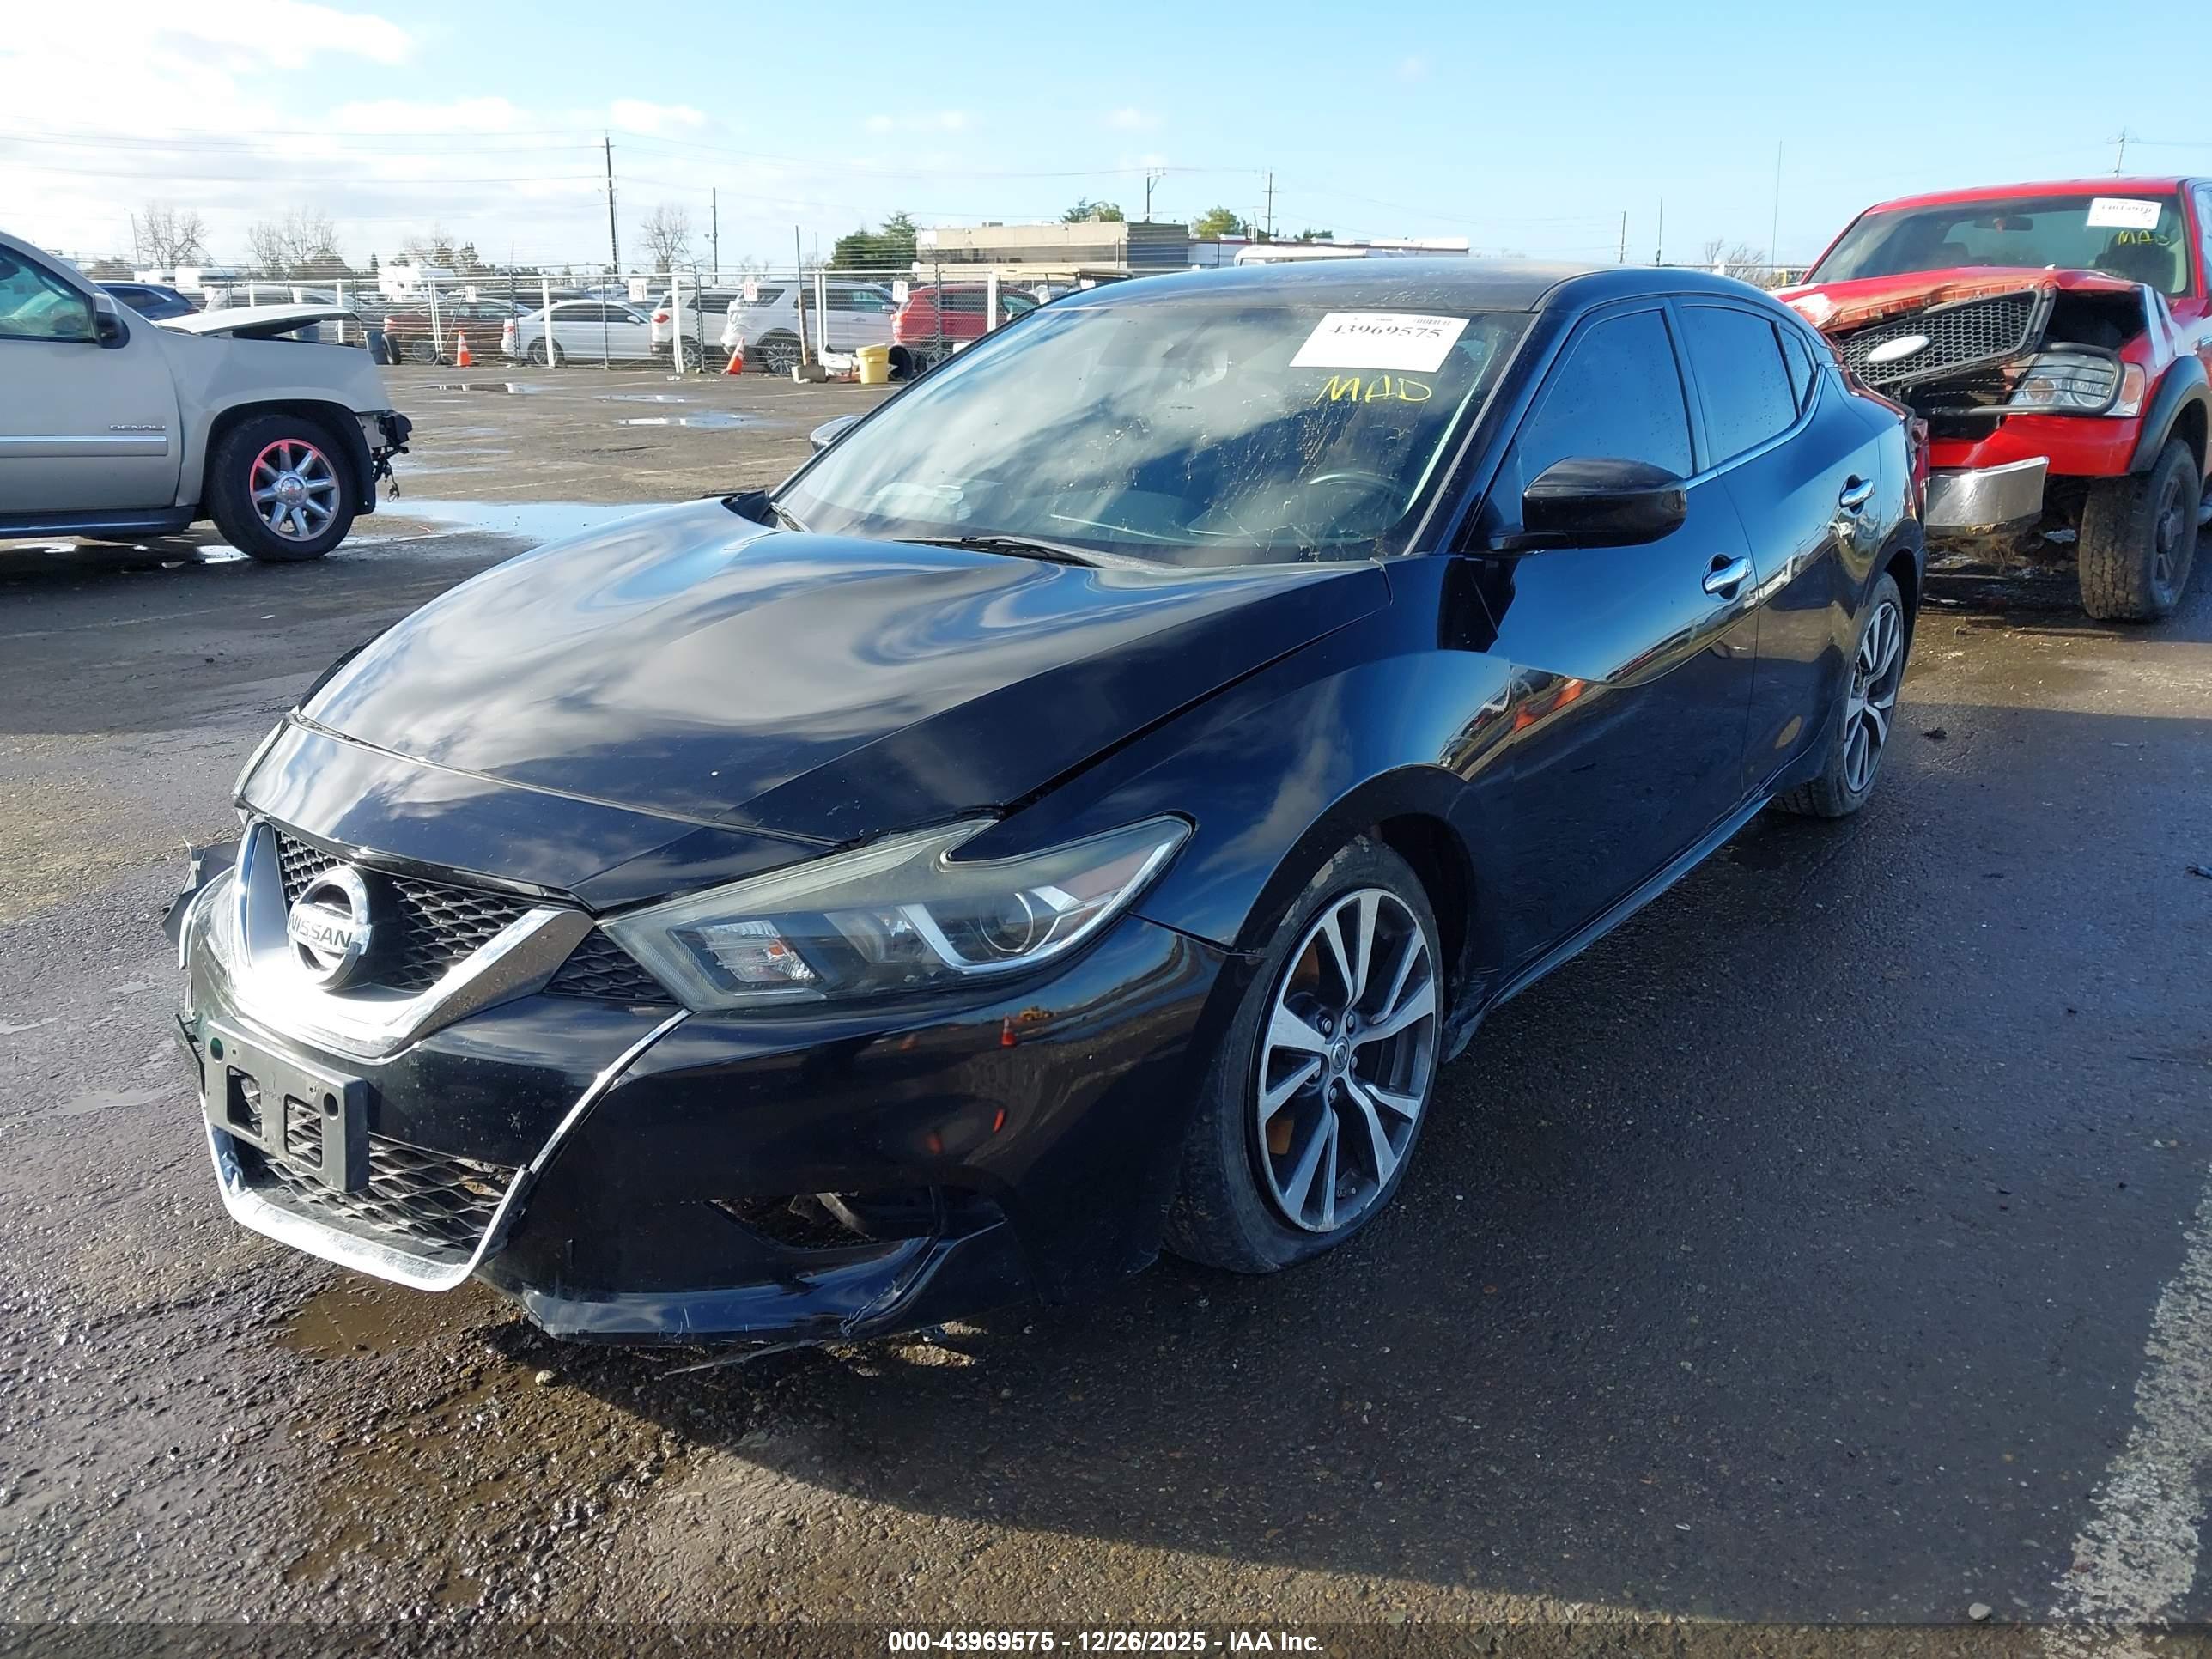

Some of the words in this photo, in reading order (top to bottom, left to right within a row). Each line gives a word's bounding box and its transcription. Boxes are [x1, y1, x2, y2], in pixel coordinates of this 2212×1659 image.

[745, 283, 755, 296] 16
[895, 283, 905, 296] 17
[1329, 324, 1443, 339] 43969575
[1312, 375, 1432, 404] MAD
[288, 912, 353, 948] NISSAN
